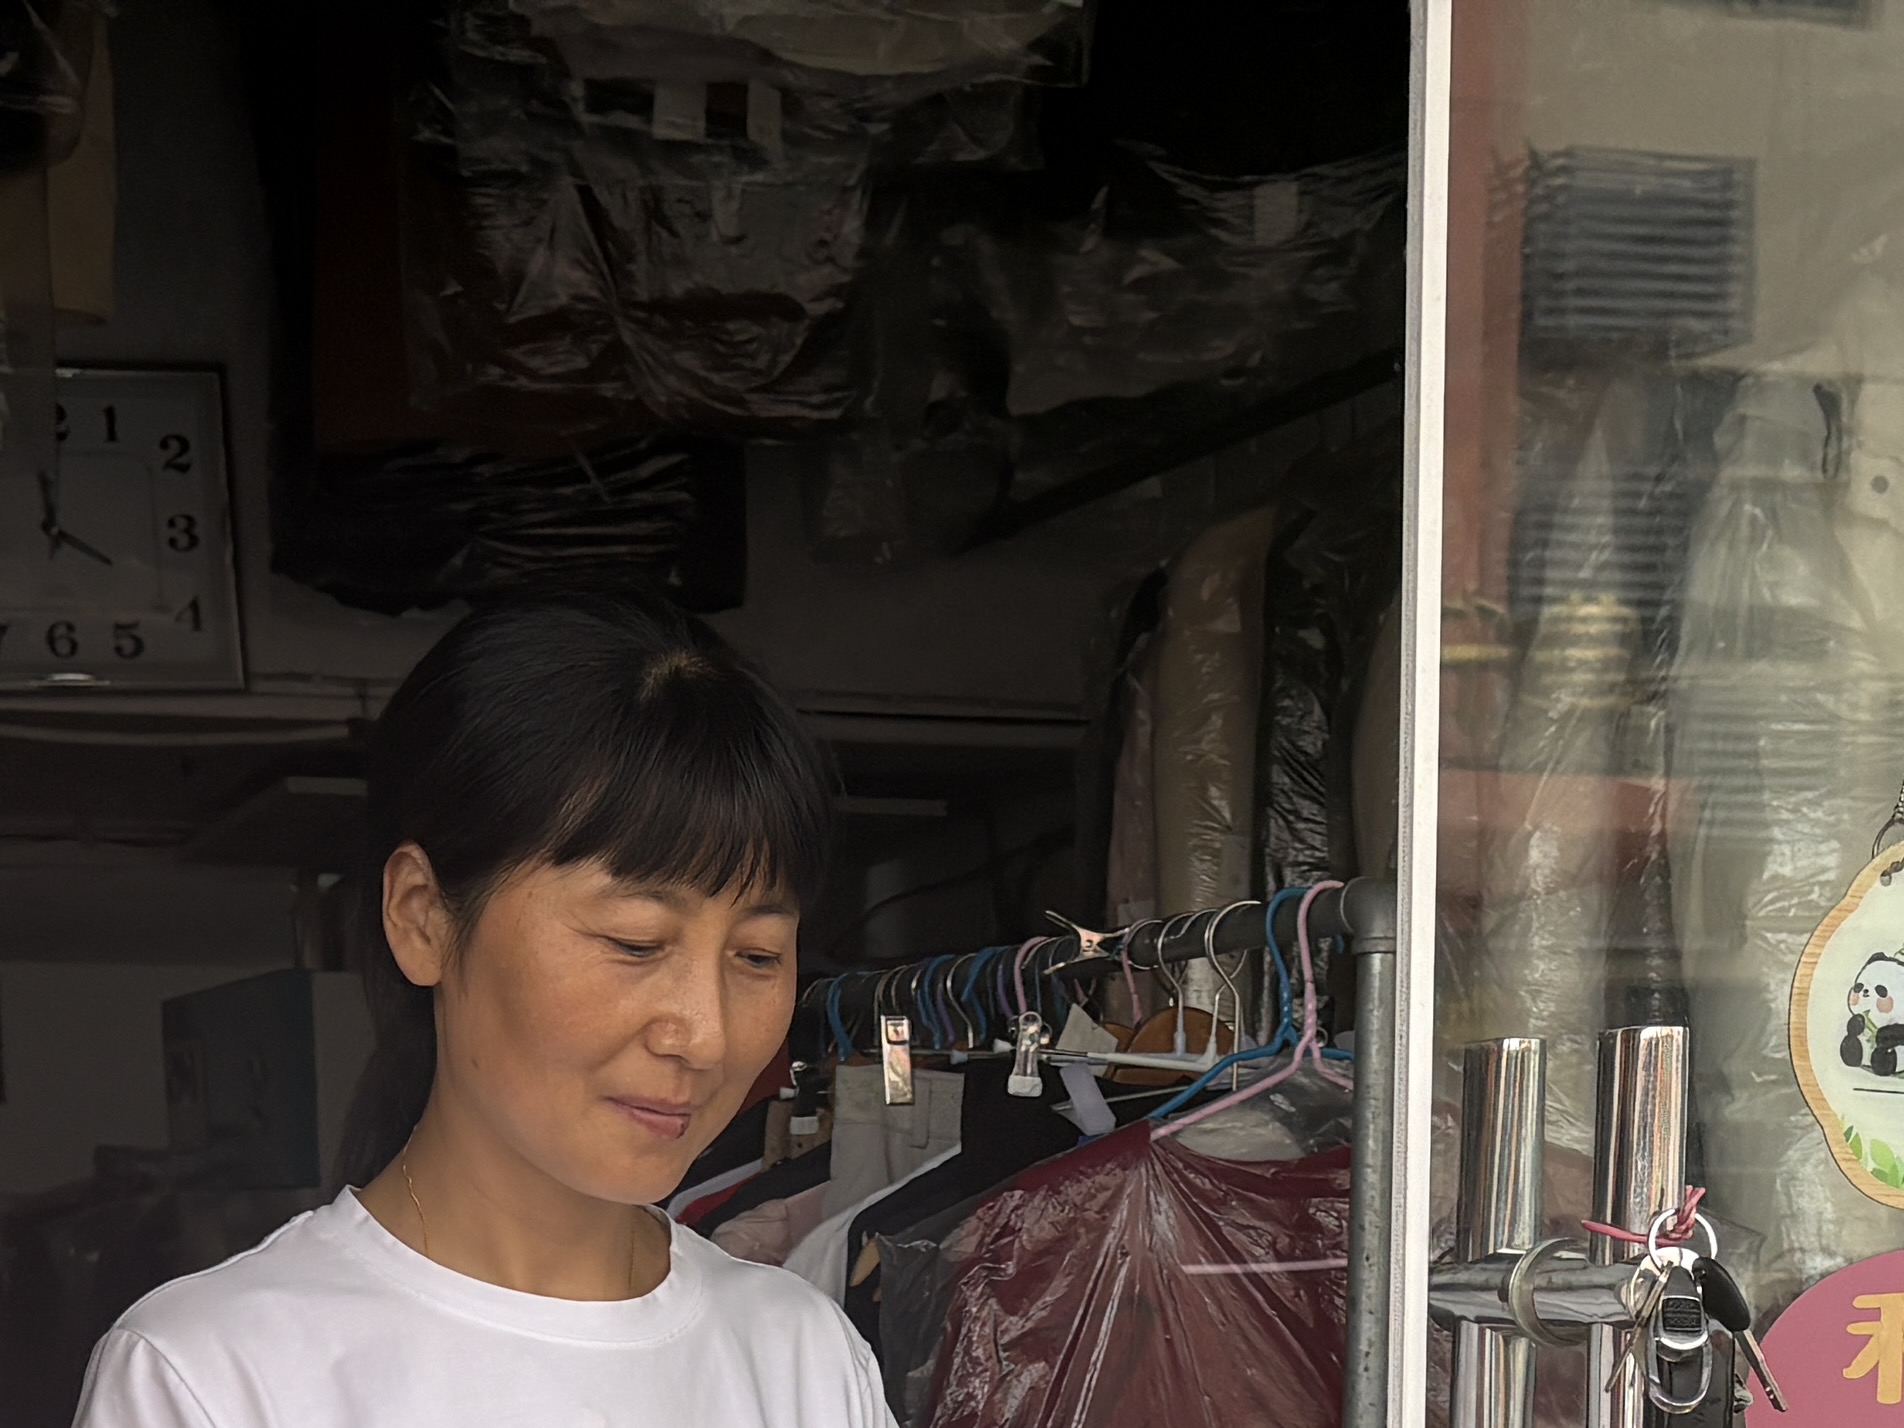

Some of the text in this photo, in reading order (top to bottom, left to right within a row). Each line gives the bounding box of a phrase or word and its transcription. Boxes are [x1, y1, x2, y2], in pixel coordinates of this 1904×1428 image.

[159, 434, 192, 474] 2
[166, 514, 198, 552] 3
[46, 621, 78, 658] 6
[114, 621, 144, 658] 5
